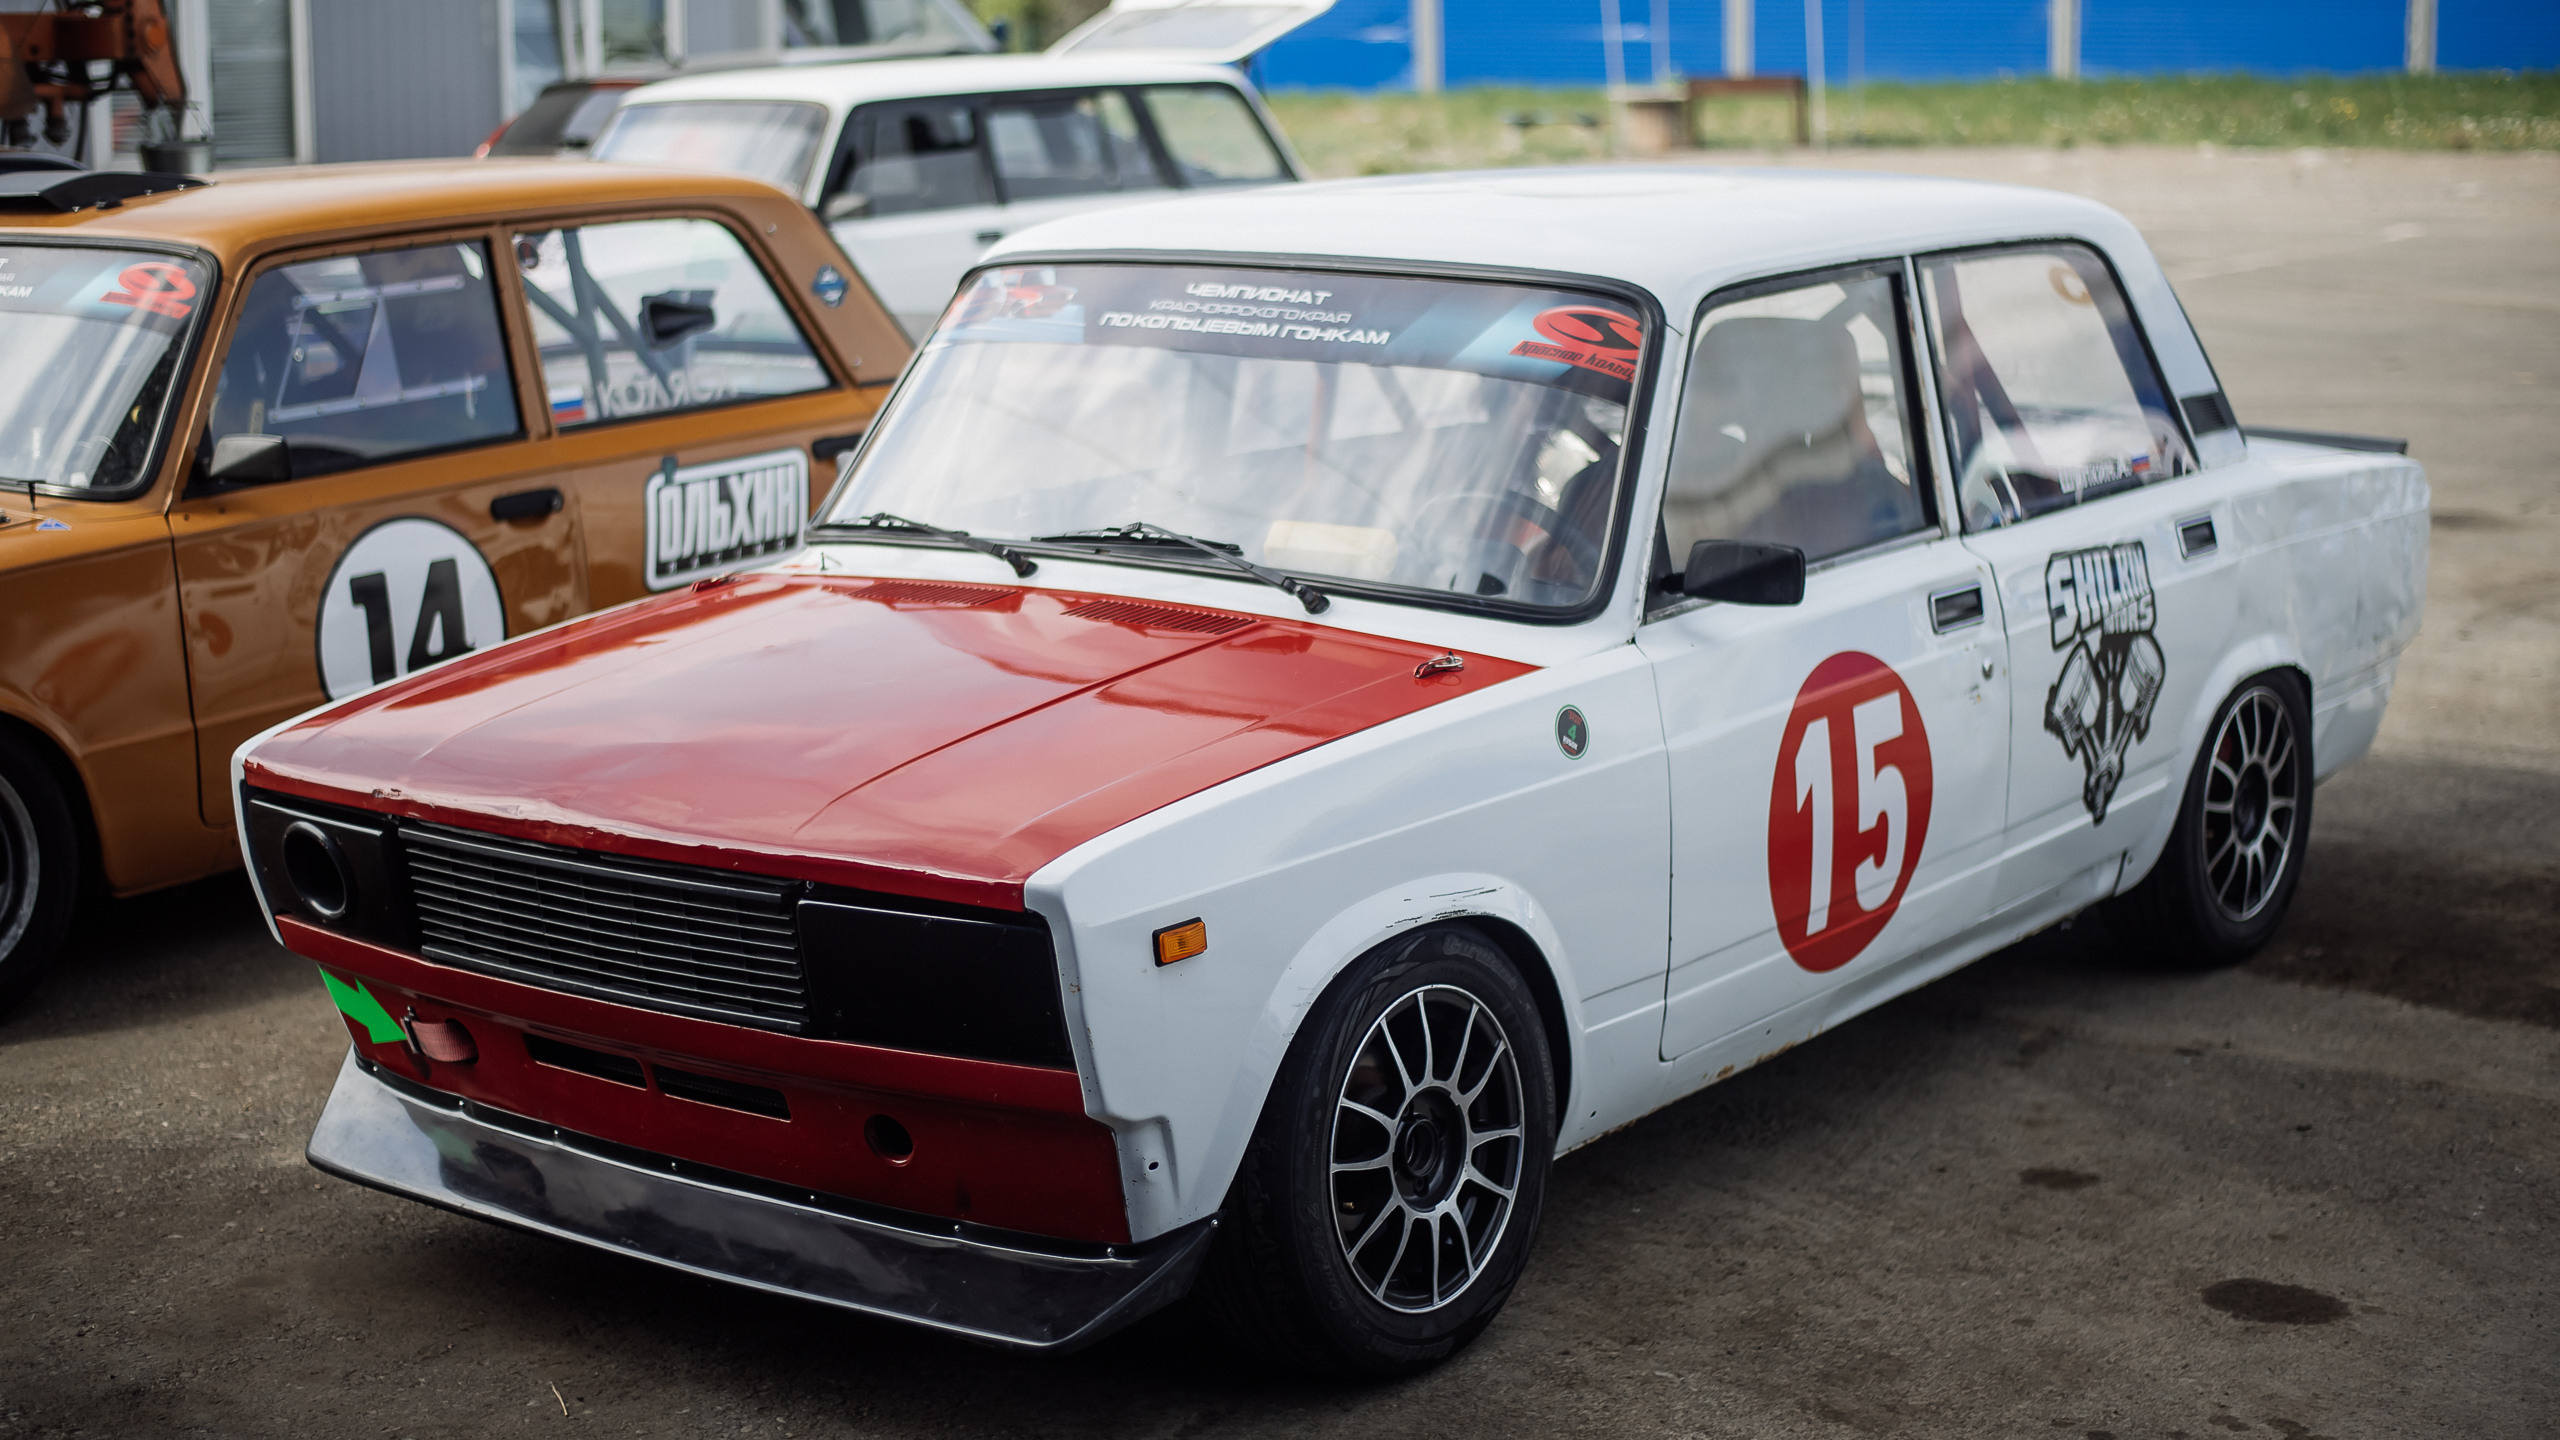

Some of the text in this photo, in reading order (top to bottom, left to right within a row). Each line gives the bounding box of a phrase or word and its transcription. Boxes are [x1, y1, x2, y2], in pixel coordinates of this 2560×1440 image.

[1185, 282, 1333, 305] ЧЕМПИОНАТ
[1280, 323, 1391, 345] ГОНКАМ
[657, 464, 798, 563] ОЛЬХИН
[349, 558, 477, 687] 14
[2046, 542, 2151, 650] SHILKIN
[1794, 689, 1908, 937] 15
